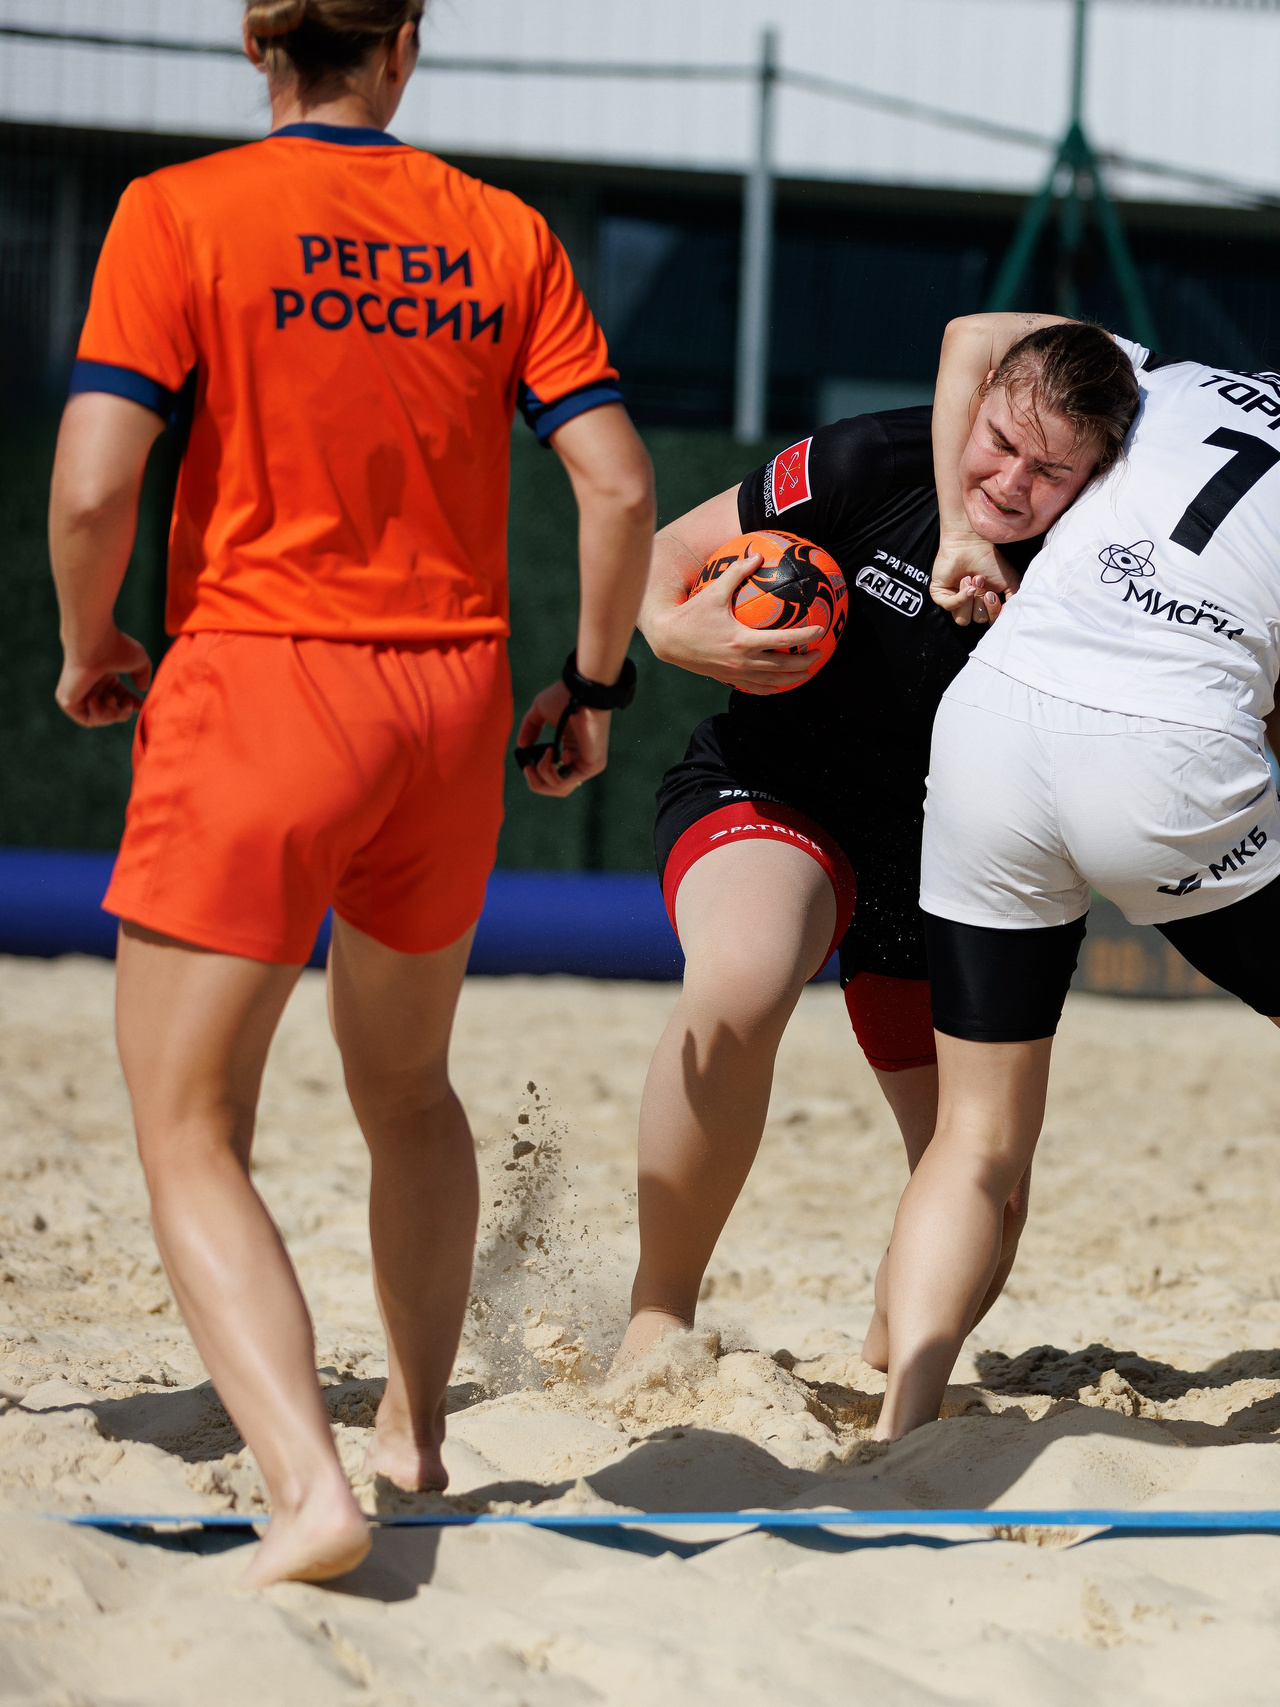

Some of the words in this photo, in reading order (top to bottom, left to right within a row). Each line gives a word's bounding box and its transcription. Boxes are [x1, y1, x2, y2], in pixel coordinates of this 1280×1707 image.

[298, 234, 473, 288] РЕГБИ
[271, 287, 506, 345] РОССИИ
[858, 571, 921, 613] ARLIFT
[885, 555, 931, 586] PATRICK
[730, 824, 824, 857] PATRICK
[1208, 824, 1268, 881] МКБ
